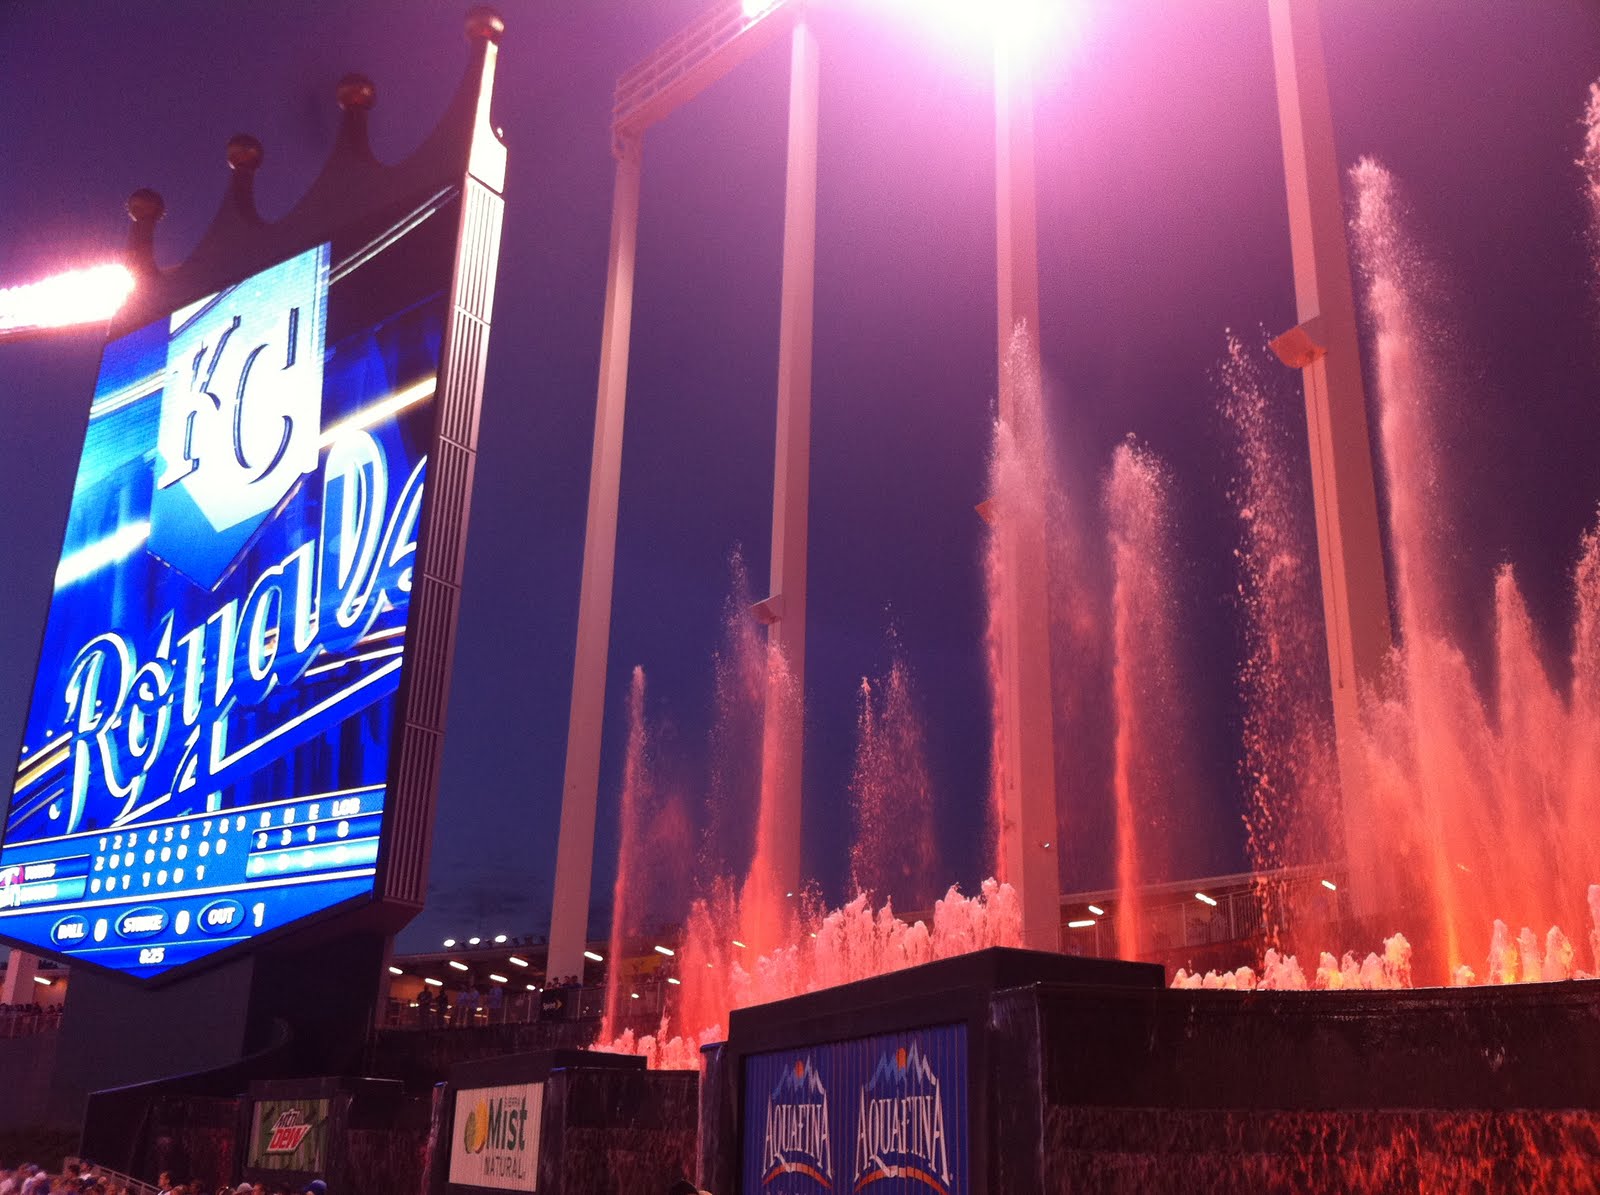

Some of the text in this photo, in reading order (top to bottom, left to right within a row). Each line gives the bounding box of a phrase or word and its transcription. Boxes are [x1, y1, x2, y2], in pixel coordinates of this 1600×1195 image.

[157, 306, 300, 490] KC
[94, 856, 104, 871] 2
[109, 854, 119, 869] 0
[125, 852, 135, 867] 0
[145, 849, 155, 864] 0
[161, 847, 171, 862] 0
[177, 845, 188, 860] 0
[199, 841, 209, 857] 0
[216, 839, 226, 855] 0
[257, 832, 268, 849] 2
[281, 829, 292, 846] 3
[307, 825, 316, 842] 1
[100, 838, 107, 852] 1
[113, 835, 122, 850] 2
[128, 833, 137, 848] 3
[148, 830, 158, 845] 4
[164, 827, 173, 842] 5
[181, 825, 190, 840] 6
[203, 821, 212, 837] 7
[219, 818, 229, 834] 8
[308, 804, 320, 820] E
[90, 865, 204, 894] 0 0 1 1 0 0 1
[93, 918, 108, 942] 0
[175, 910, 190, 935] 0
[208, 907, 235, 925] OUT
[253, 902, 265, 928] 1
[762, 1089, 832, 1180] AQUAFINA
[853, 1078, 950, 1186] AQUAFINA
[484, 1156, 524, 1179] NATURAL
